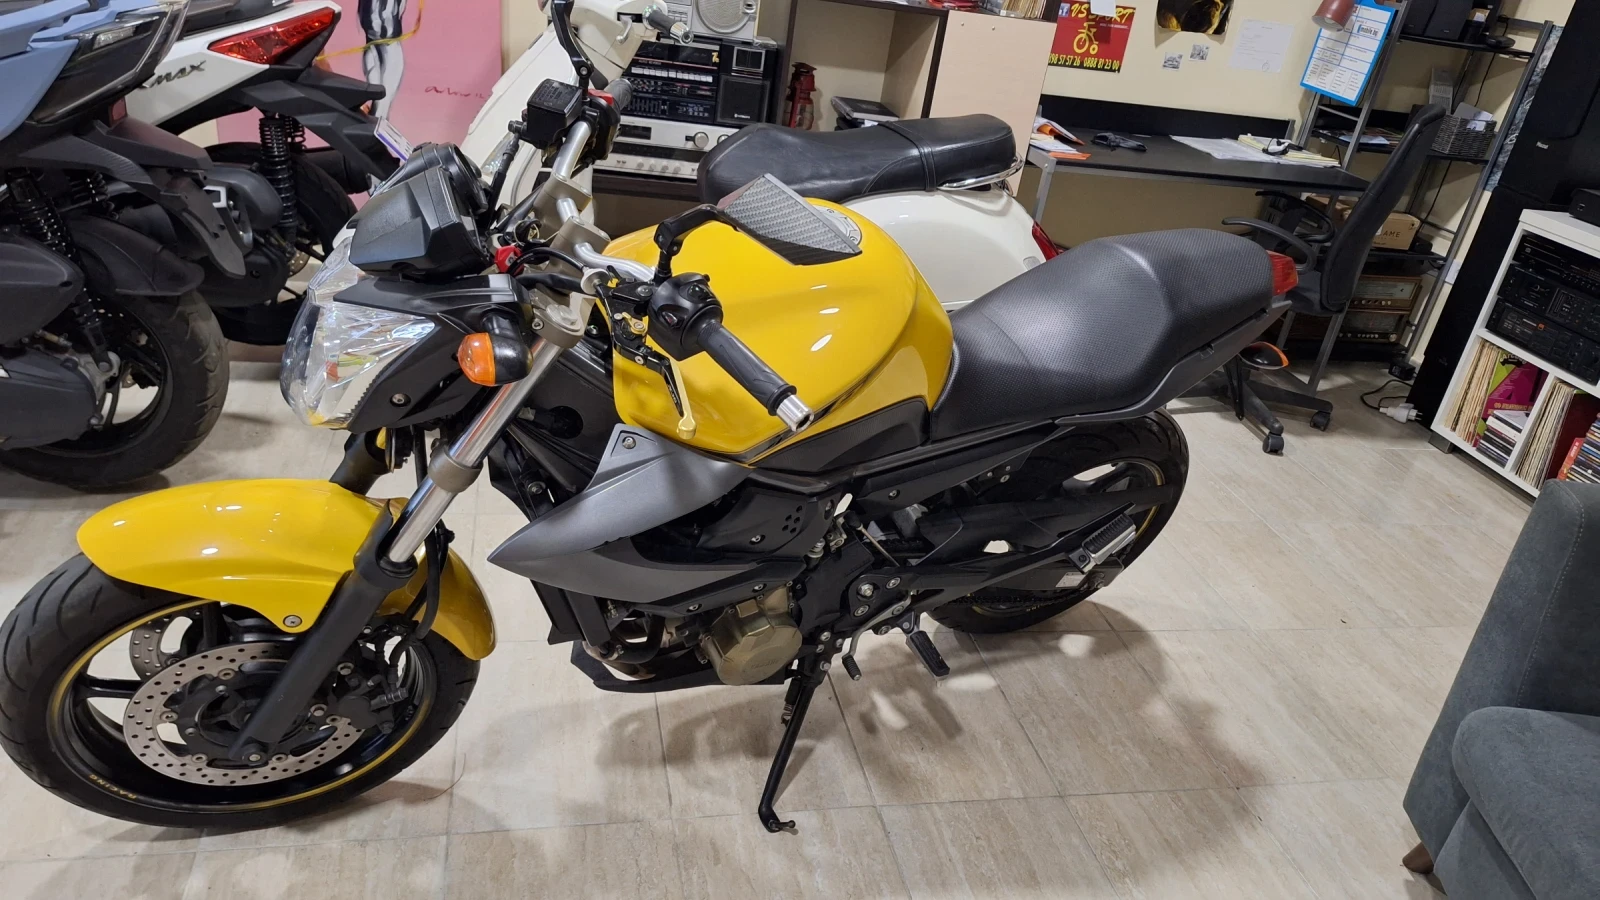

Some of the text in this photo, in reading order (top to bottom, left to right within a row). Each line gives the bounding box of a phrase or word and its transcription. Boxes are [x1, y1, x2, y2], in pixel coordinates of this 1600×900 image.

[1071, 3, 1089, 18] VS
[142, 60, 207, 88] MAX
[89, 774, 137, 799] RACING
